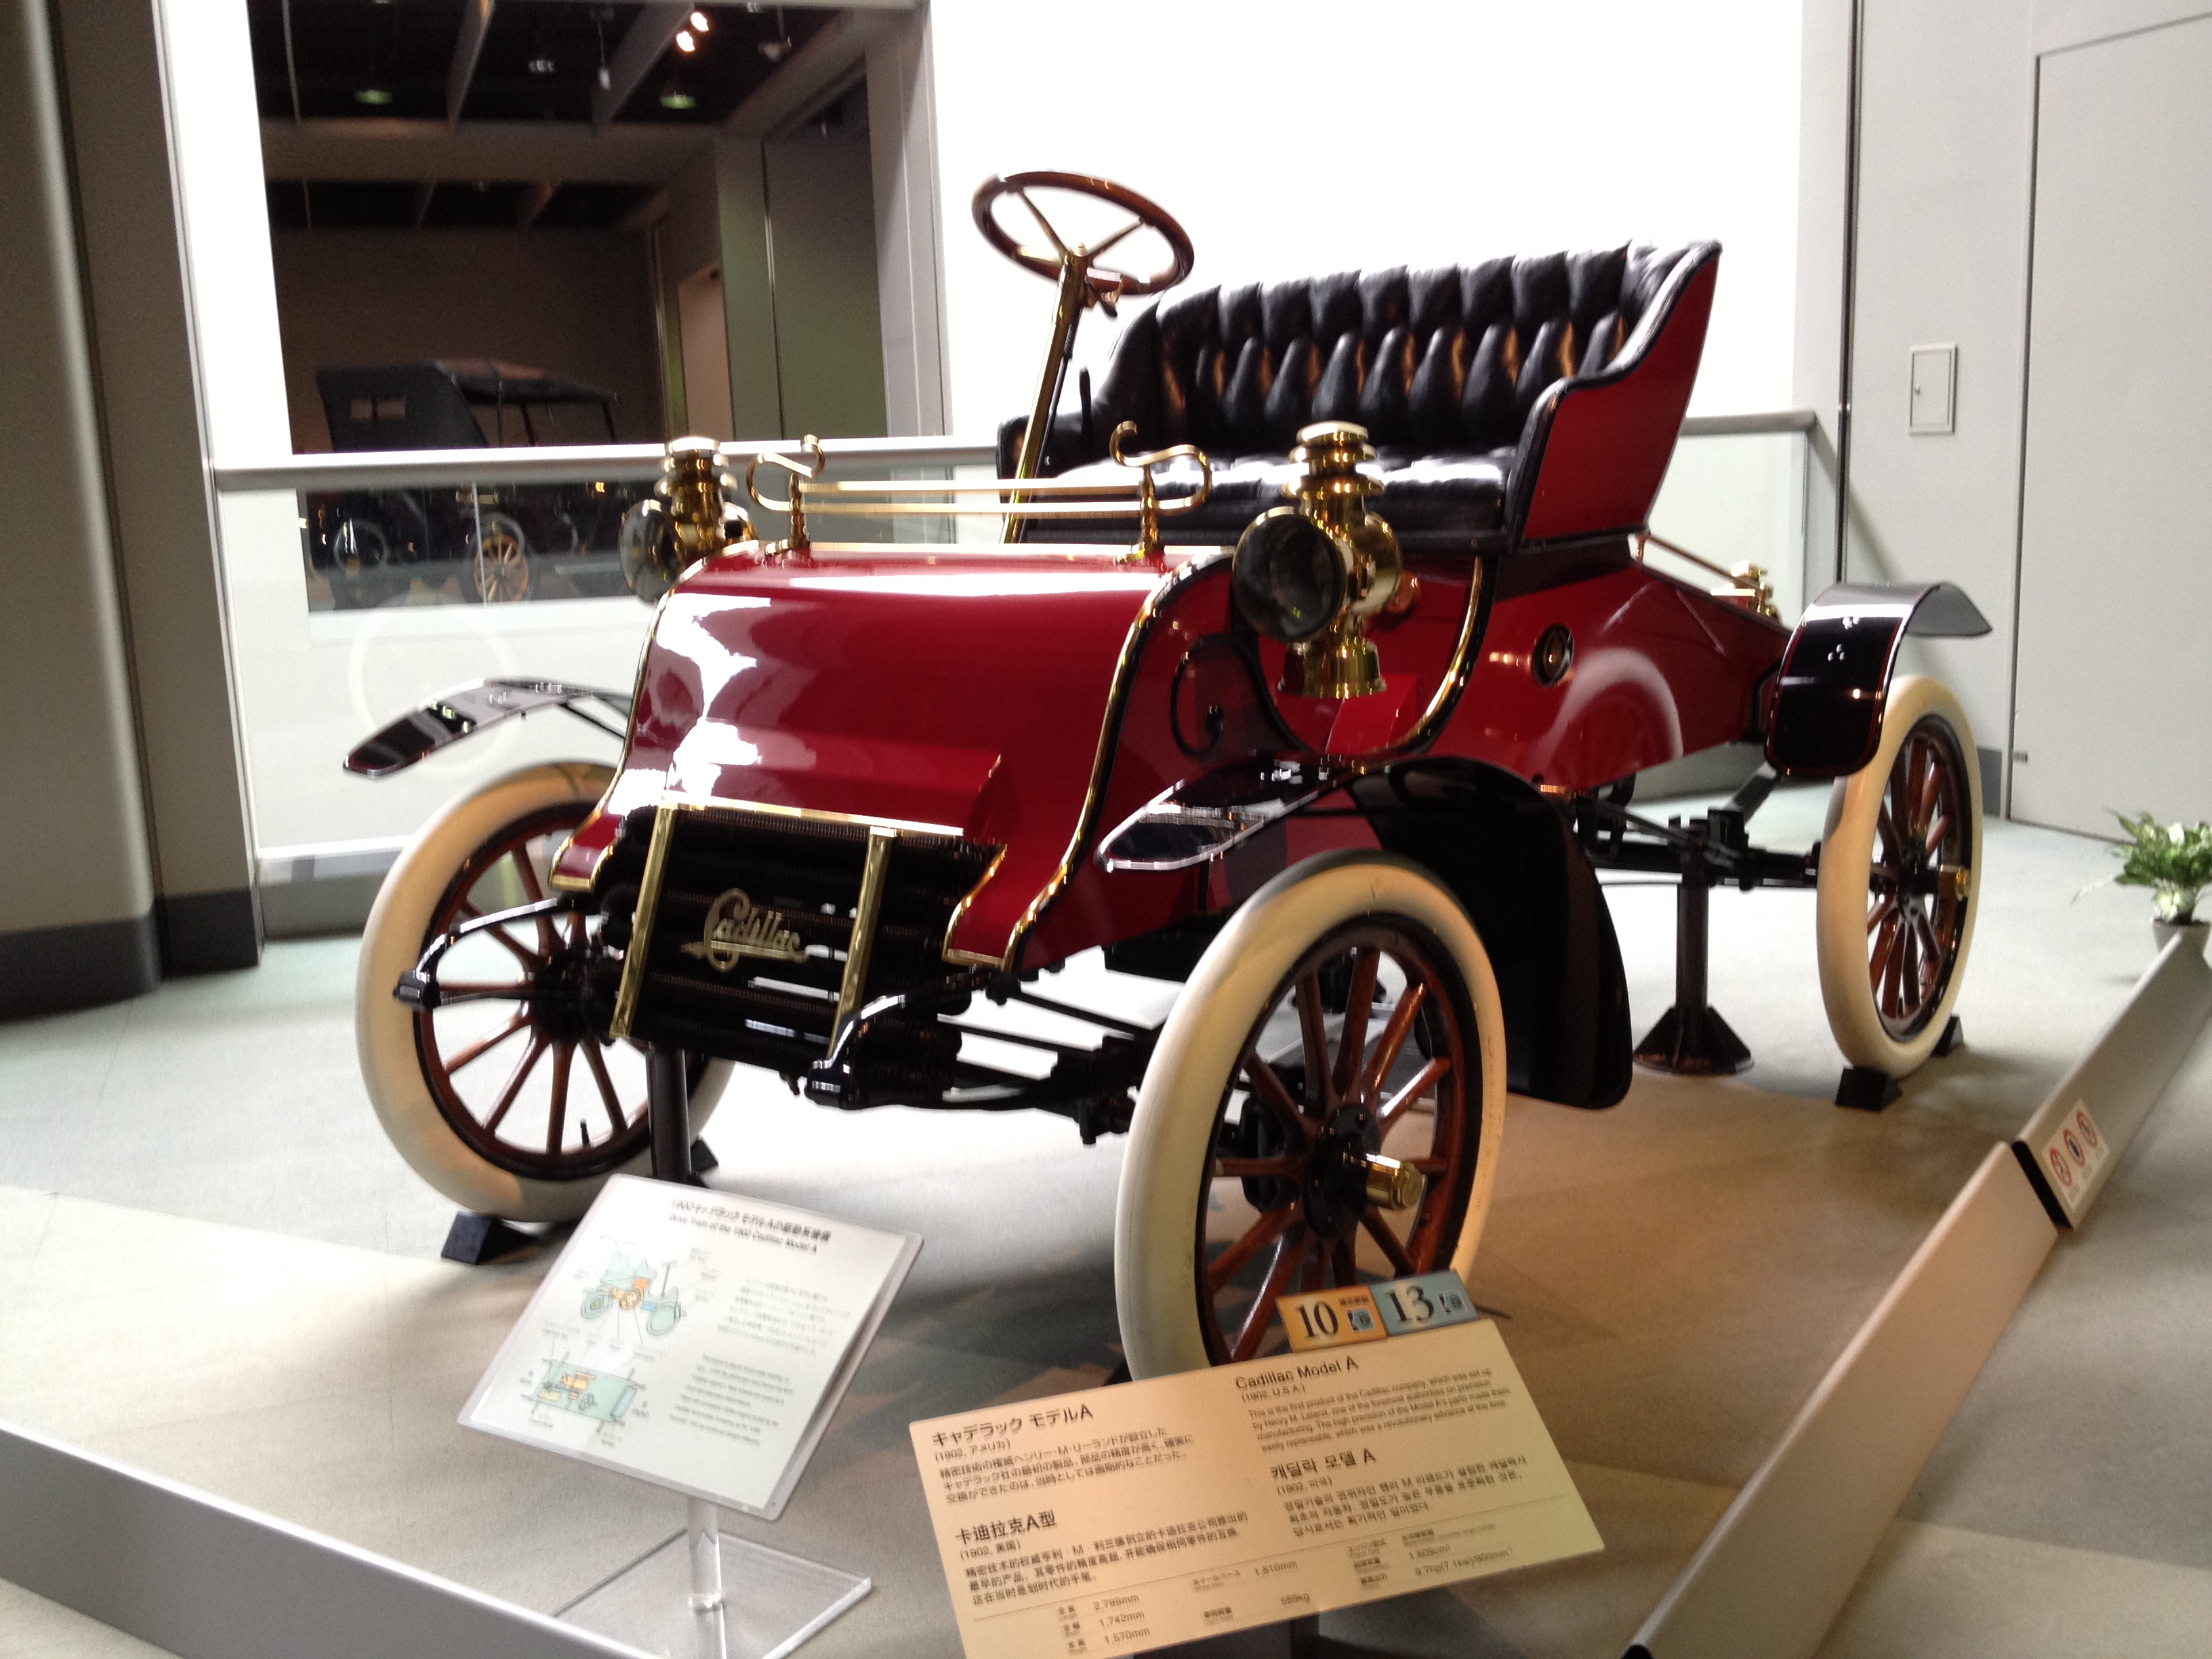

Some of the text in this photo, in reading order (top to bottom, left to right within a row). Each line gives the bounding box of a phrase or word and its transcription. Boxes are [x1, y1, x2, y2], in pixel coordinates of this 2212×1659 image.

[686, 887, 809, 974] Cadillac
[1295, 1300, 1339, 1340] 10
[1387, 1284, 1435, 1323] 13
[1235, 1355, 1359, 1389] Cadillac Model A
[932, 1404, 1093, 1447] キャデラック モデルA
[1270, 1448, 1376, 1479] 캐딜락 모델 A
[1401, 1477, 1412, 1488] M
[956, 1511, 1056, 1544] 卡迪拉克A型
